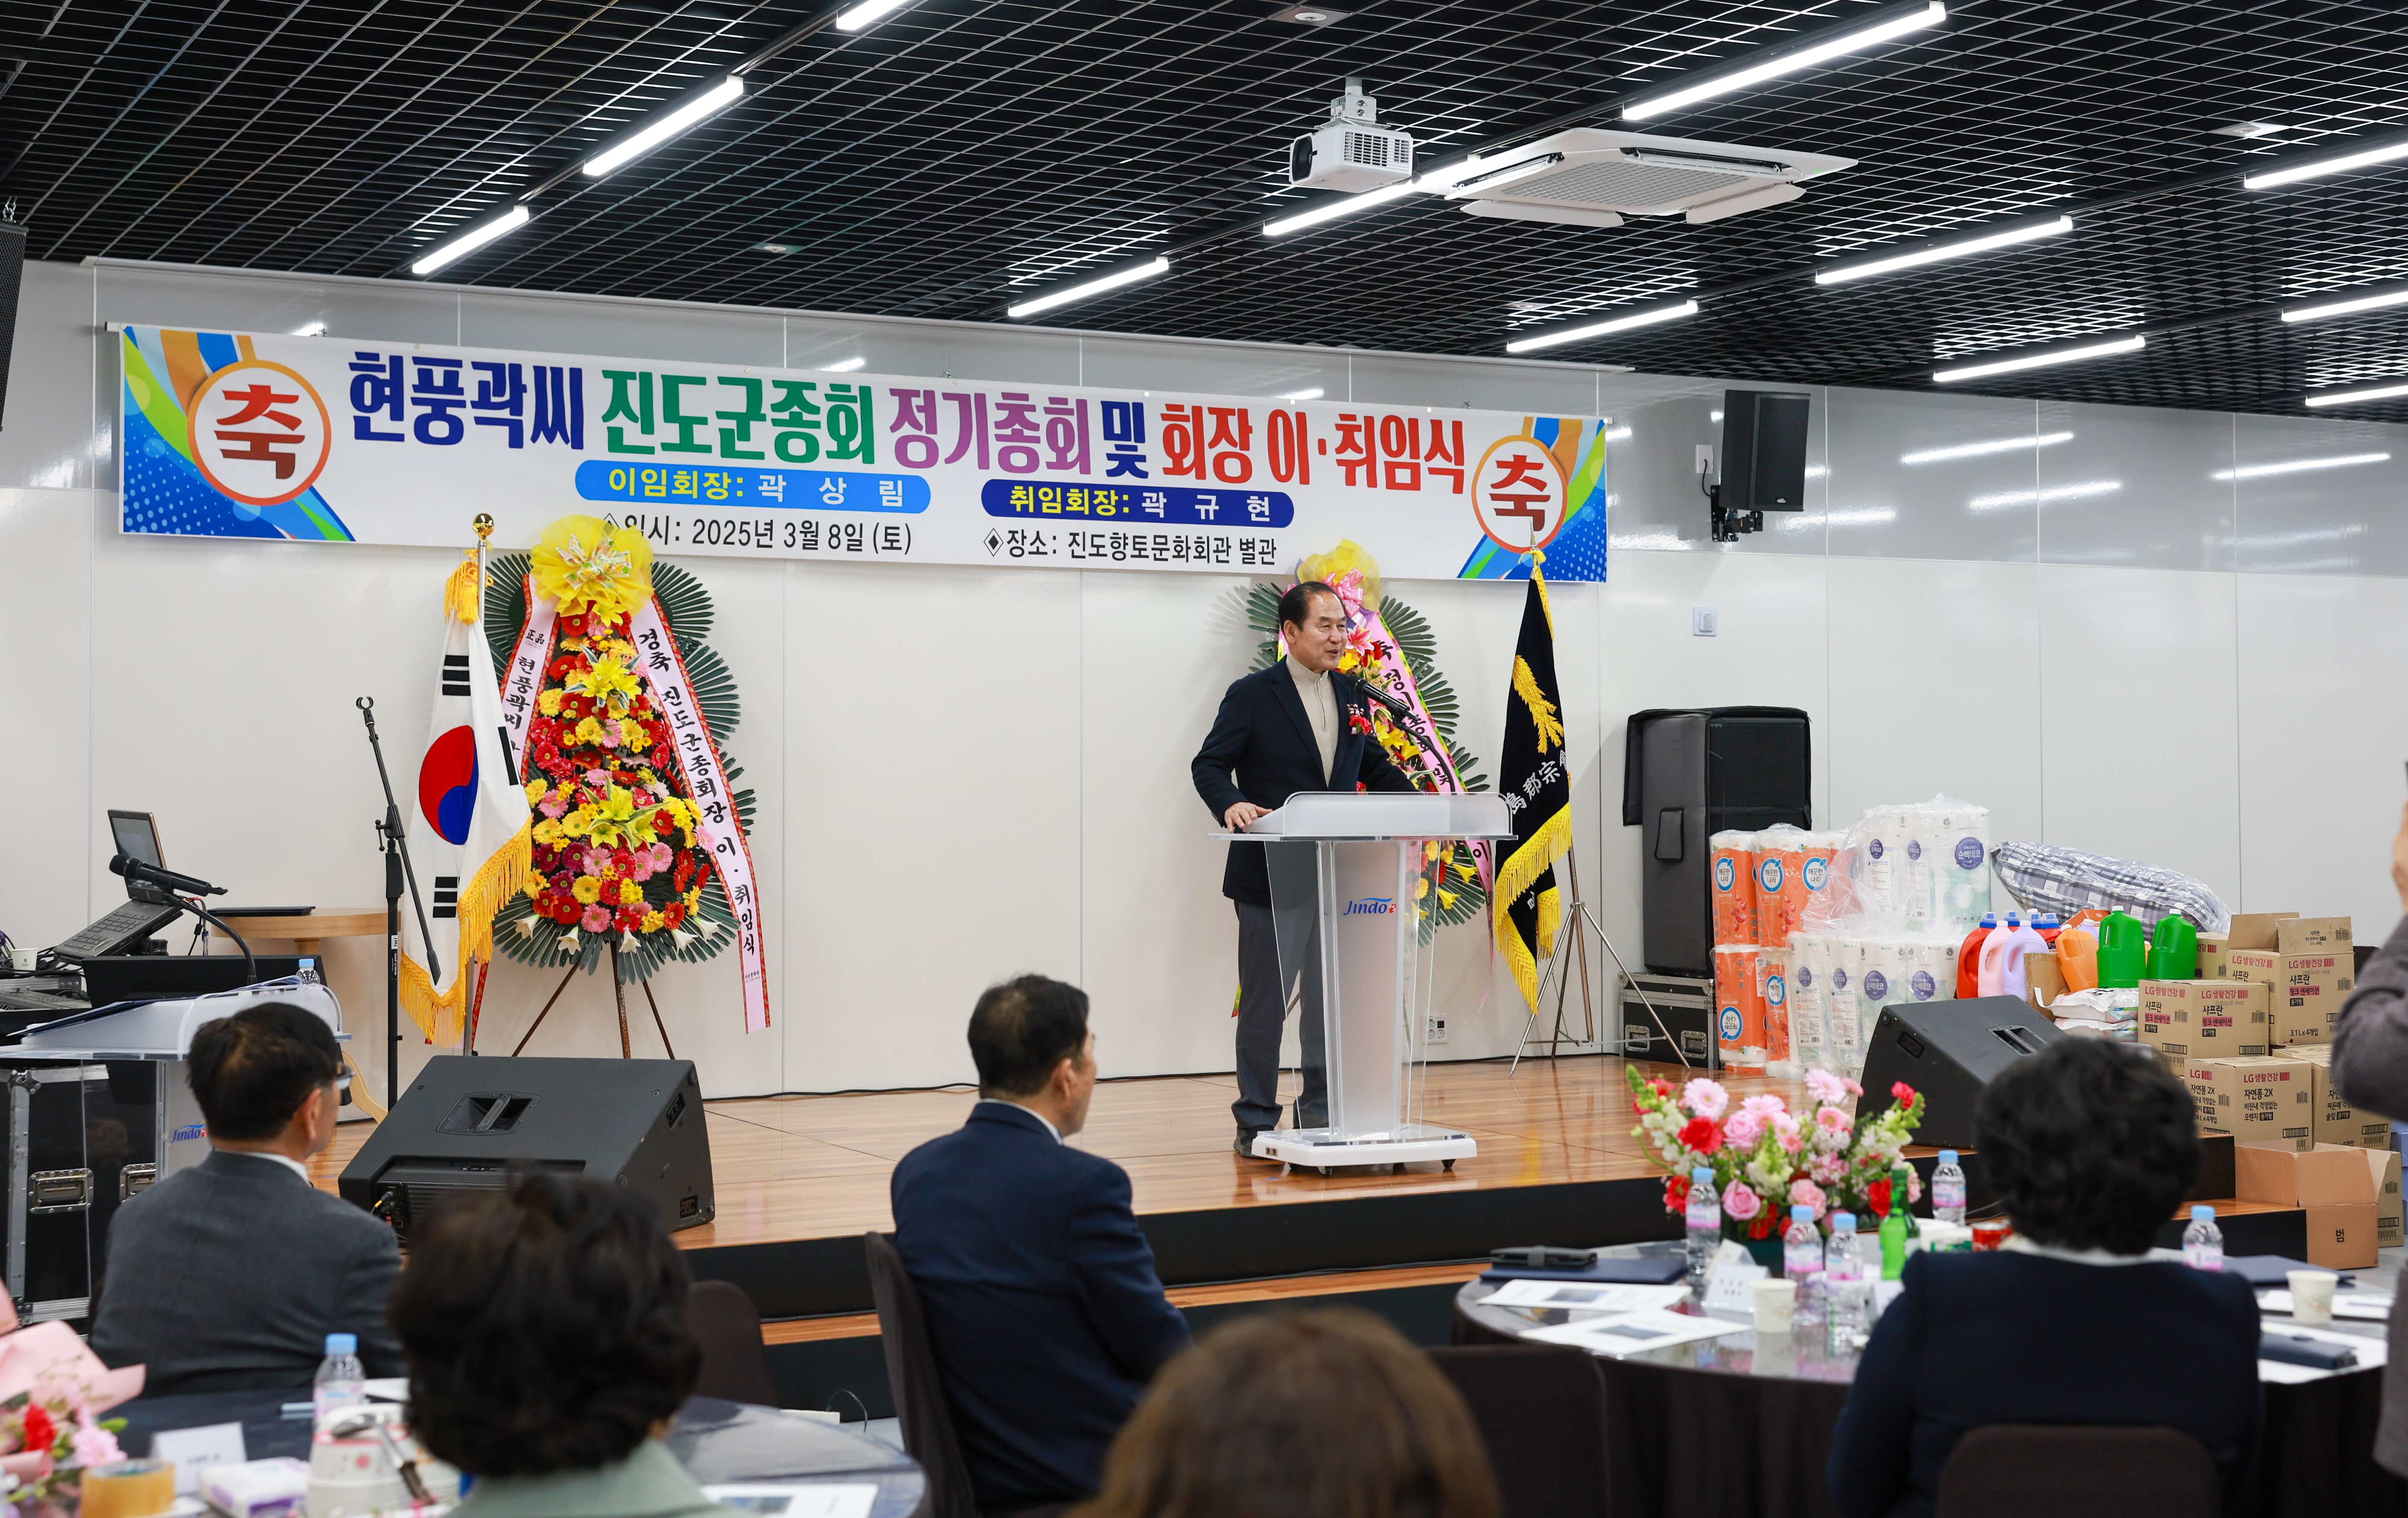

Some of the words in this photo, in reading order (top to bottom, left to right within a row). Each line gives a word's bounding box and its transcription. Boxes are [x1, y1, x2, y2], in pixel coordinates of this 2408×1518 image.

[348, 350, 585, 450] 현풍곽씨
[601, 369, 875, 465] 진도군종회
[888, 388, 1092, 476] 정기총회
[1100, 399, 1149, 479] 및
[1160, 403, 1253, 484] 회장
[213, 384, 306, 480] 축
[608, 467, 744, 500] 이임회장:
[1488, 454, 1552, 532] 축
[1009, 485, 1130, 516] 취임회장:
[692, 518, 774, 549] 2025년
[783, 520, 821, 550] 3월
[827, 523, 864, 552] 8일
[872, 522, 912, 555] (토)
[1007, 529, 1058, 558] 장소:
[1067, 530, 1232, 564] 진도향토문화회관
[1239, 537, 1277, 566] 별관
[526, 629, 545, 645] 正品
[504, 656, 536, 730] 현풍곽씨
[638, 628, 672, 672] 경축
[662, 686, 728, 824] 진도군종회장
[1958, 850, 1981, 859] 순백데코
[1343, 901, 1388, 915] Jindo
[2232, 970, 2249, 981] 샤프란
[2290, 975, 2310, 985] 샤프란
[2300, 987, 2319, 995] 센세이션
[2145, 1001, 2162, 1013] 샤프란
[2202, 1005, 2223, 1016] 샤프란
[2145, 1014, 2153, 1022] 핑크
[2154, 1015, 2170, 1024] 센세이션
[2213, 1018, 2232, 1026] 센세이션
[2190, 1069, 2200, 1078] LG
[2191, 1084, 2206, 1095] 자연퐁
[2244, 1089, 2263, 1100] 자연퐁
[2264, 1089, 2273, 1097] 2X
[2259, 1101, 2278, 1110] 걱정없는
[2244, 1112, 2258, 1121] 오렌지
[171, 1128, 201, 1144] Jindo
[2336, 1229, 2344, 1243] 범
